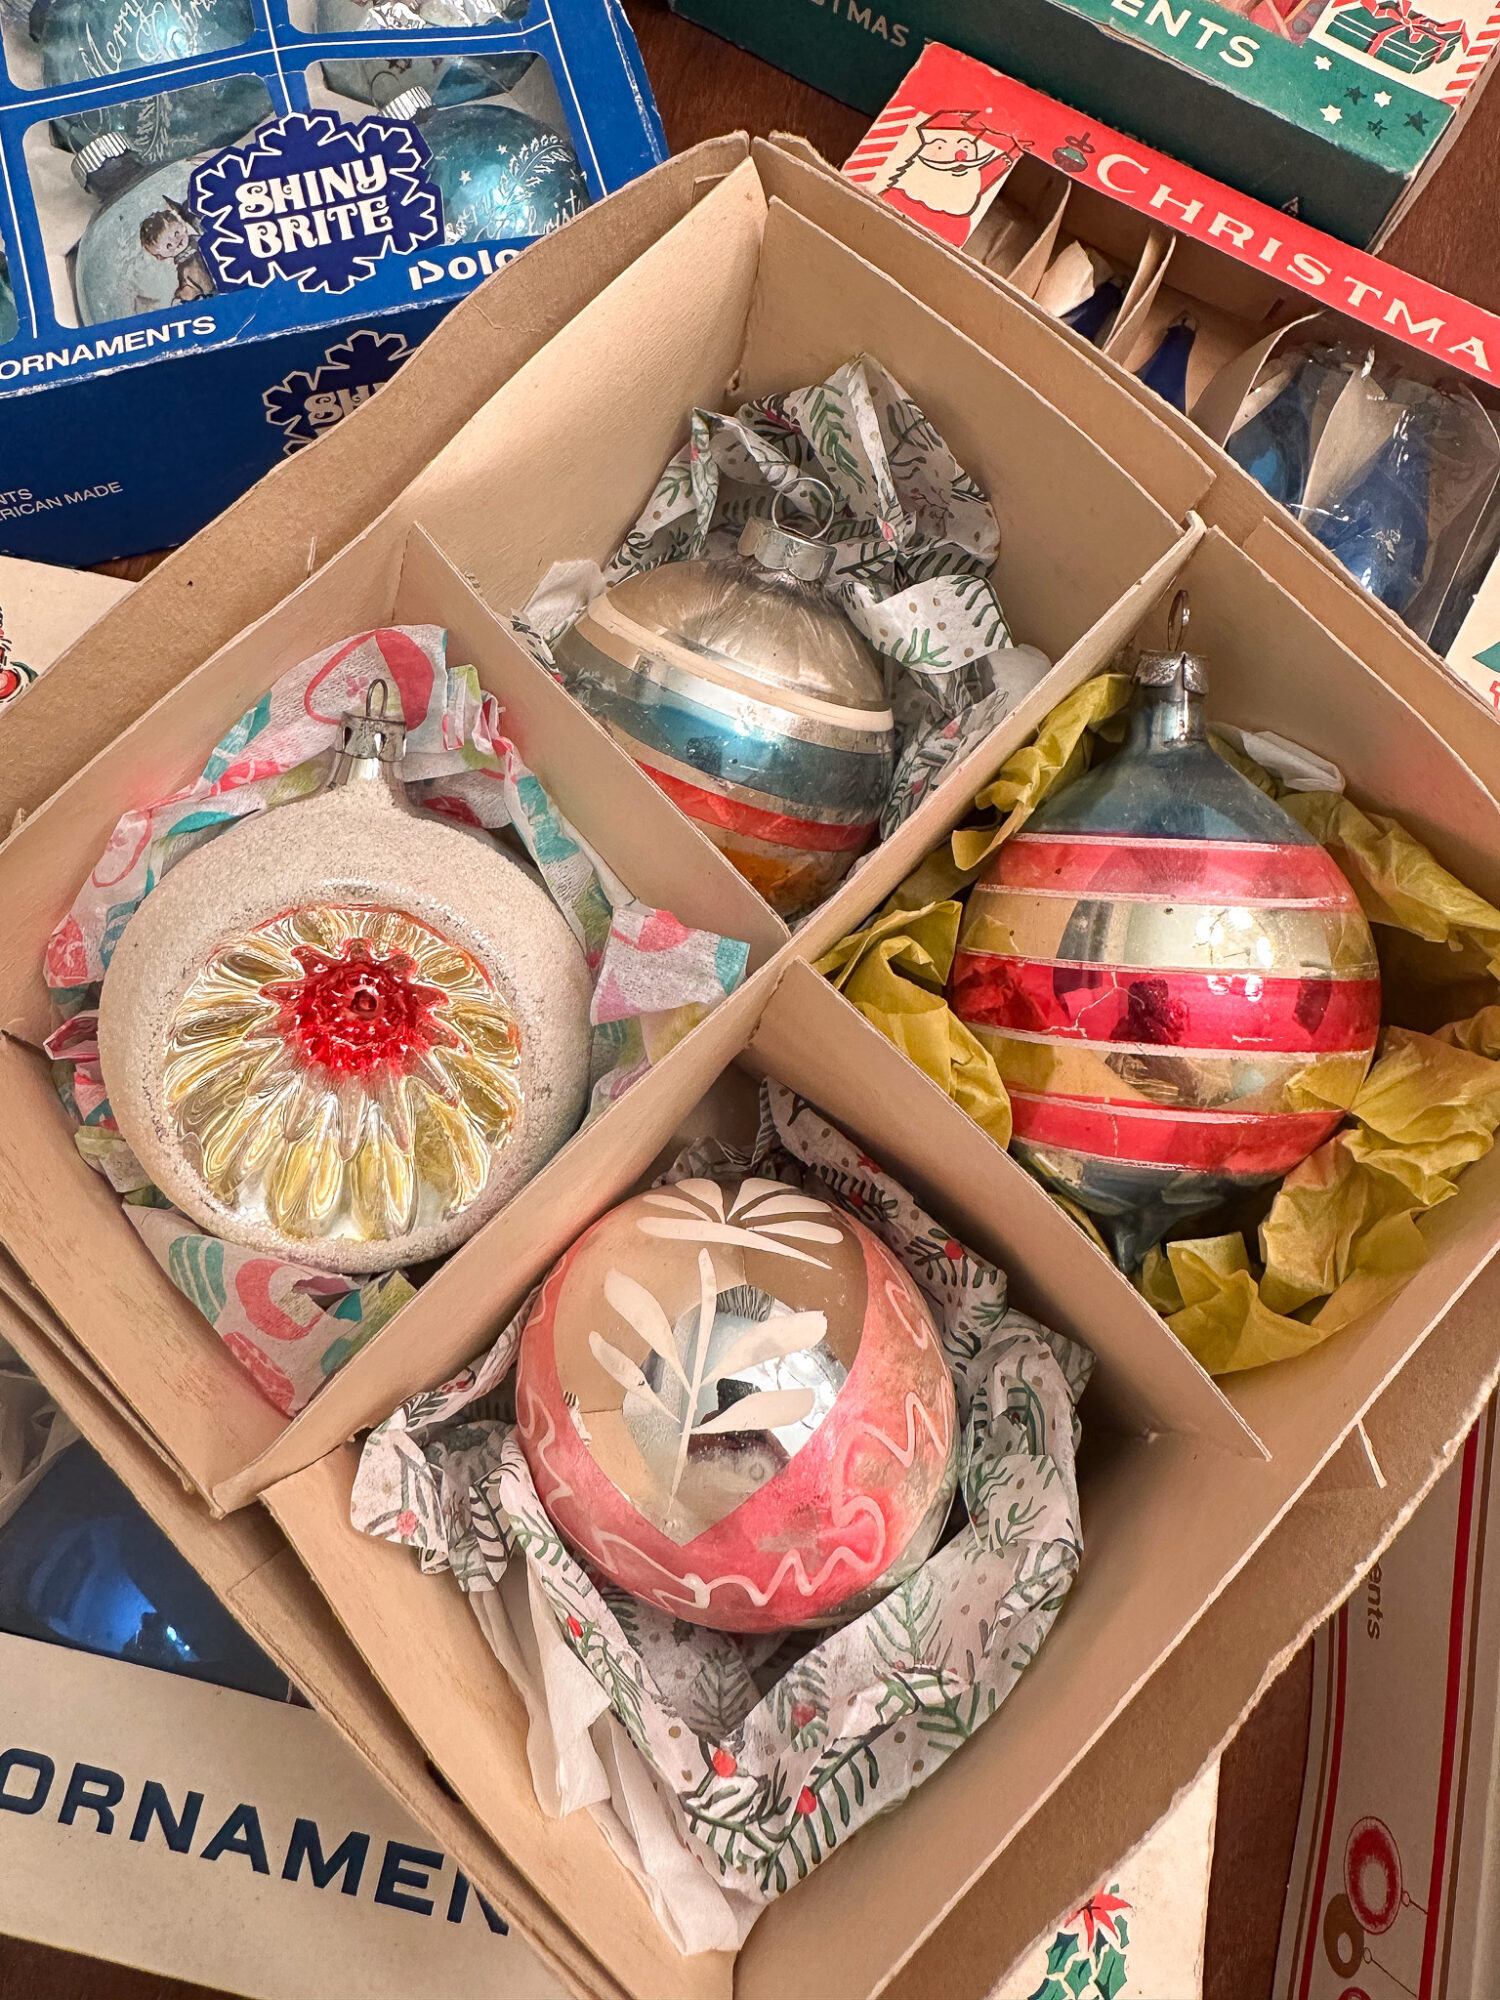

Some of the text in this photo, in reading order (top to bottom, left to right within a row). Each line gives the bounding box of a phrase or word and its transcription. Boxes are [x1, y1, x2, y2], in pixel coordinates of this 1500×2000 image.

[235, 154, 387, 220] SHINY
[244, 195, 394, 258] BRITE
[1097, 153, 1492, 373] CHRISTMA
[0, 316, 216, 380] ORNAMENTS
[0, 481, 124, 521] RICAN MADE
